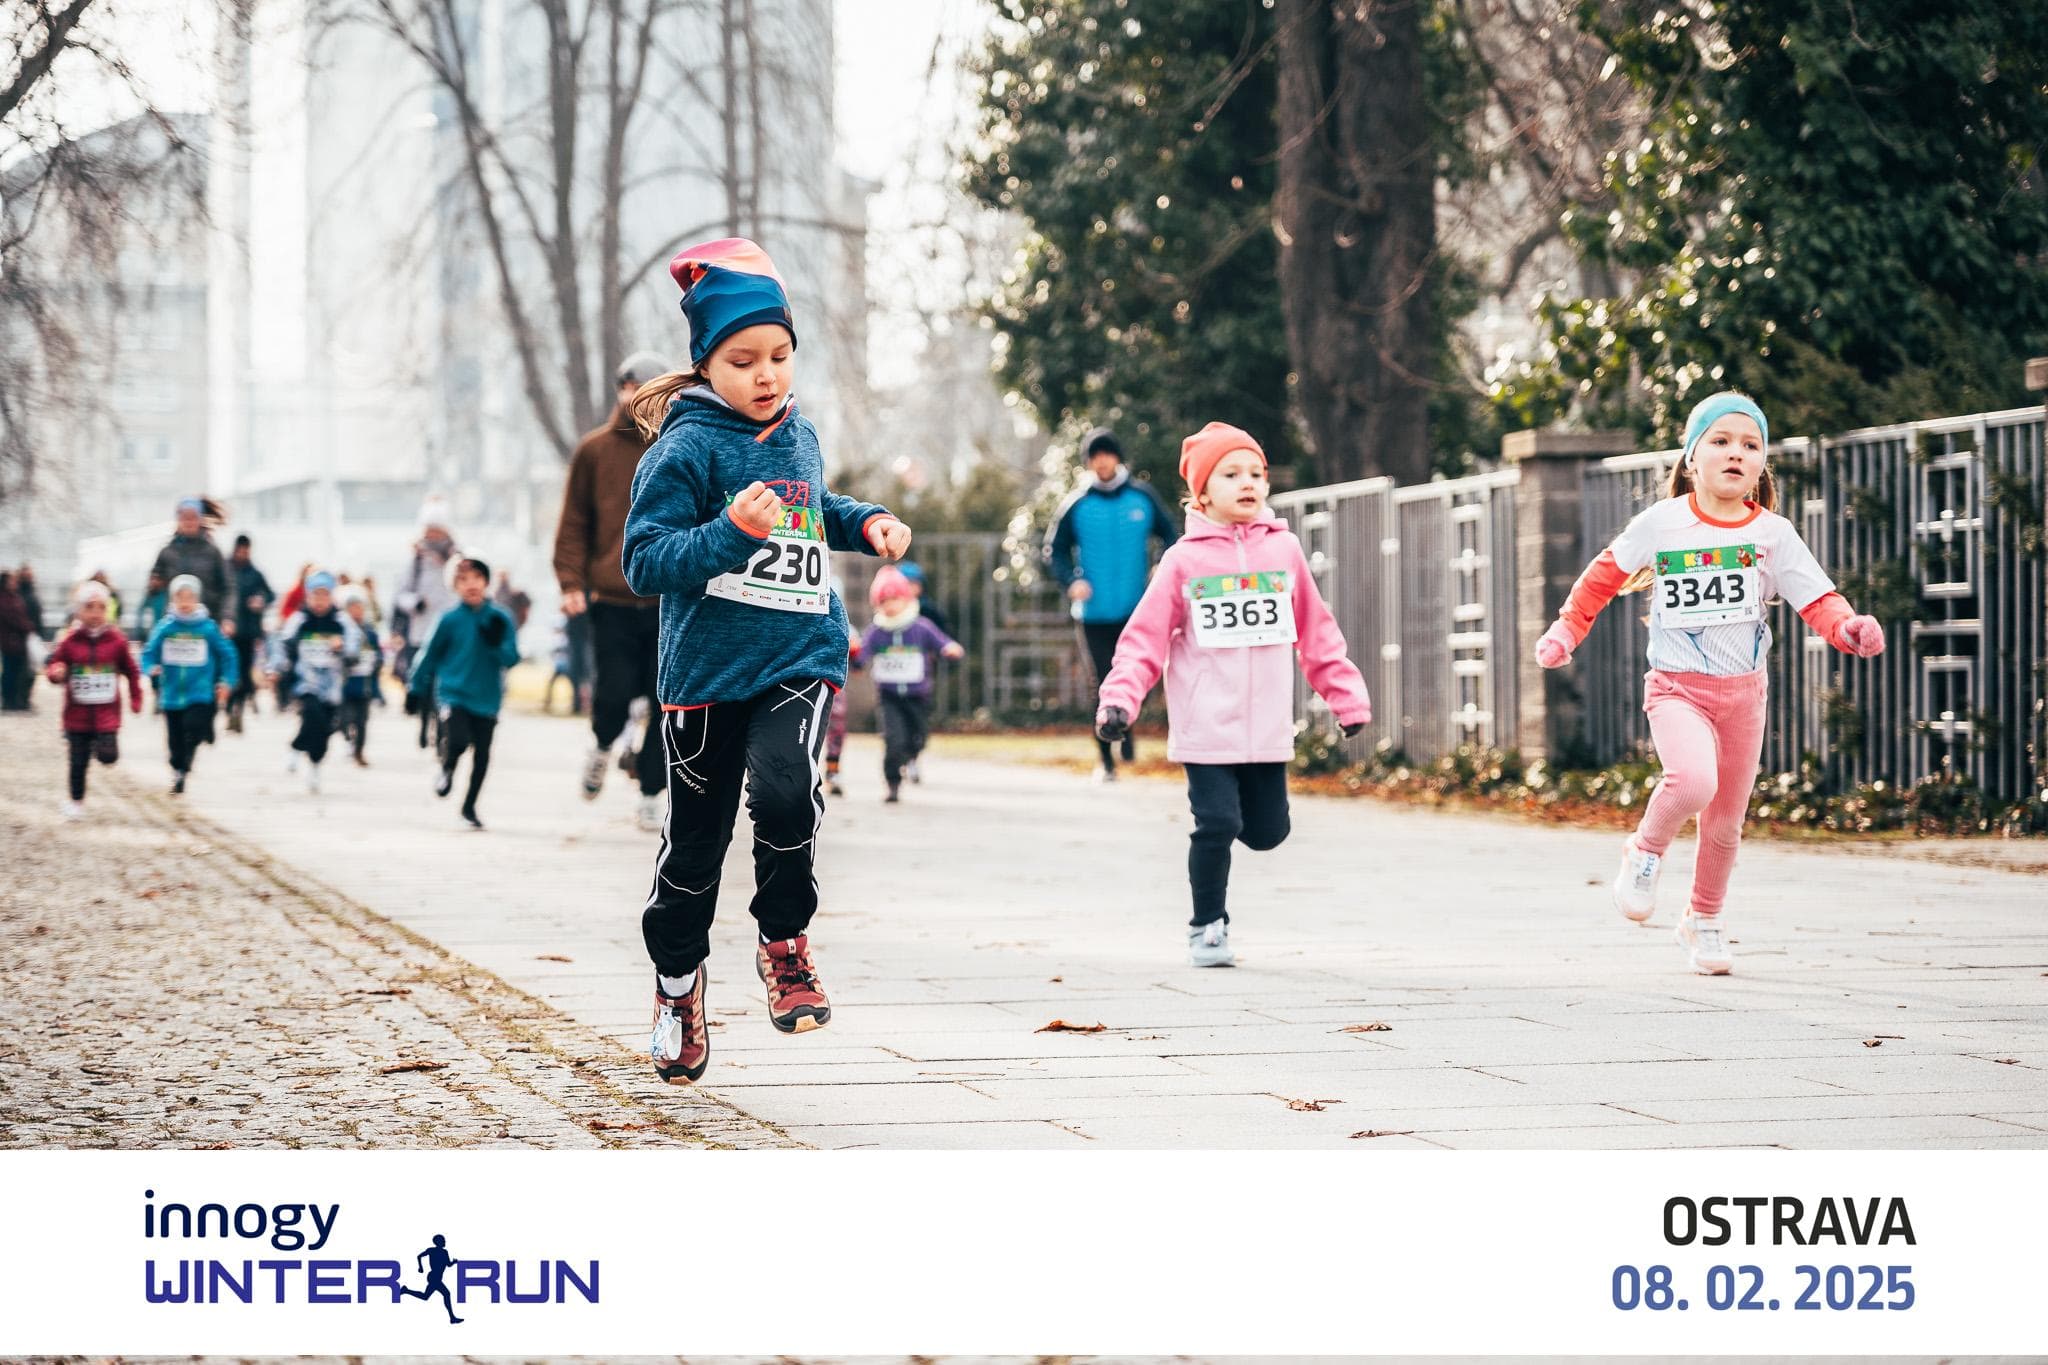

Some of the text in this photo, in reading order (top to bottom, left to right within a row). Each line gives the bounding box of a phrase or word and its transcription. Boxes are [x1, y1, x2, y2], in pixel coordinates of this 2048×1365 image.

[1664, 574, 1745, 608] 3343
[1201, 599, 1278, 629] 3363
[676, 768, 701, 790] CRAFT
